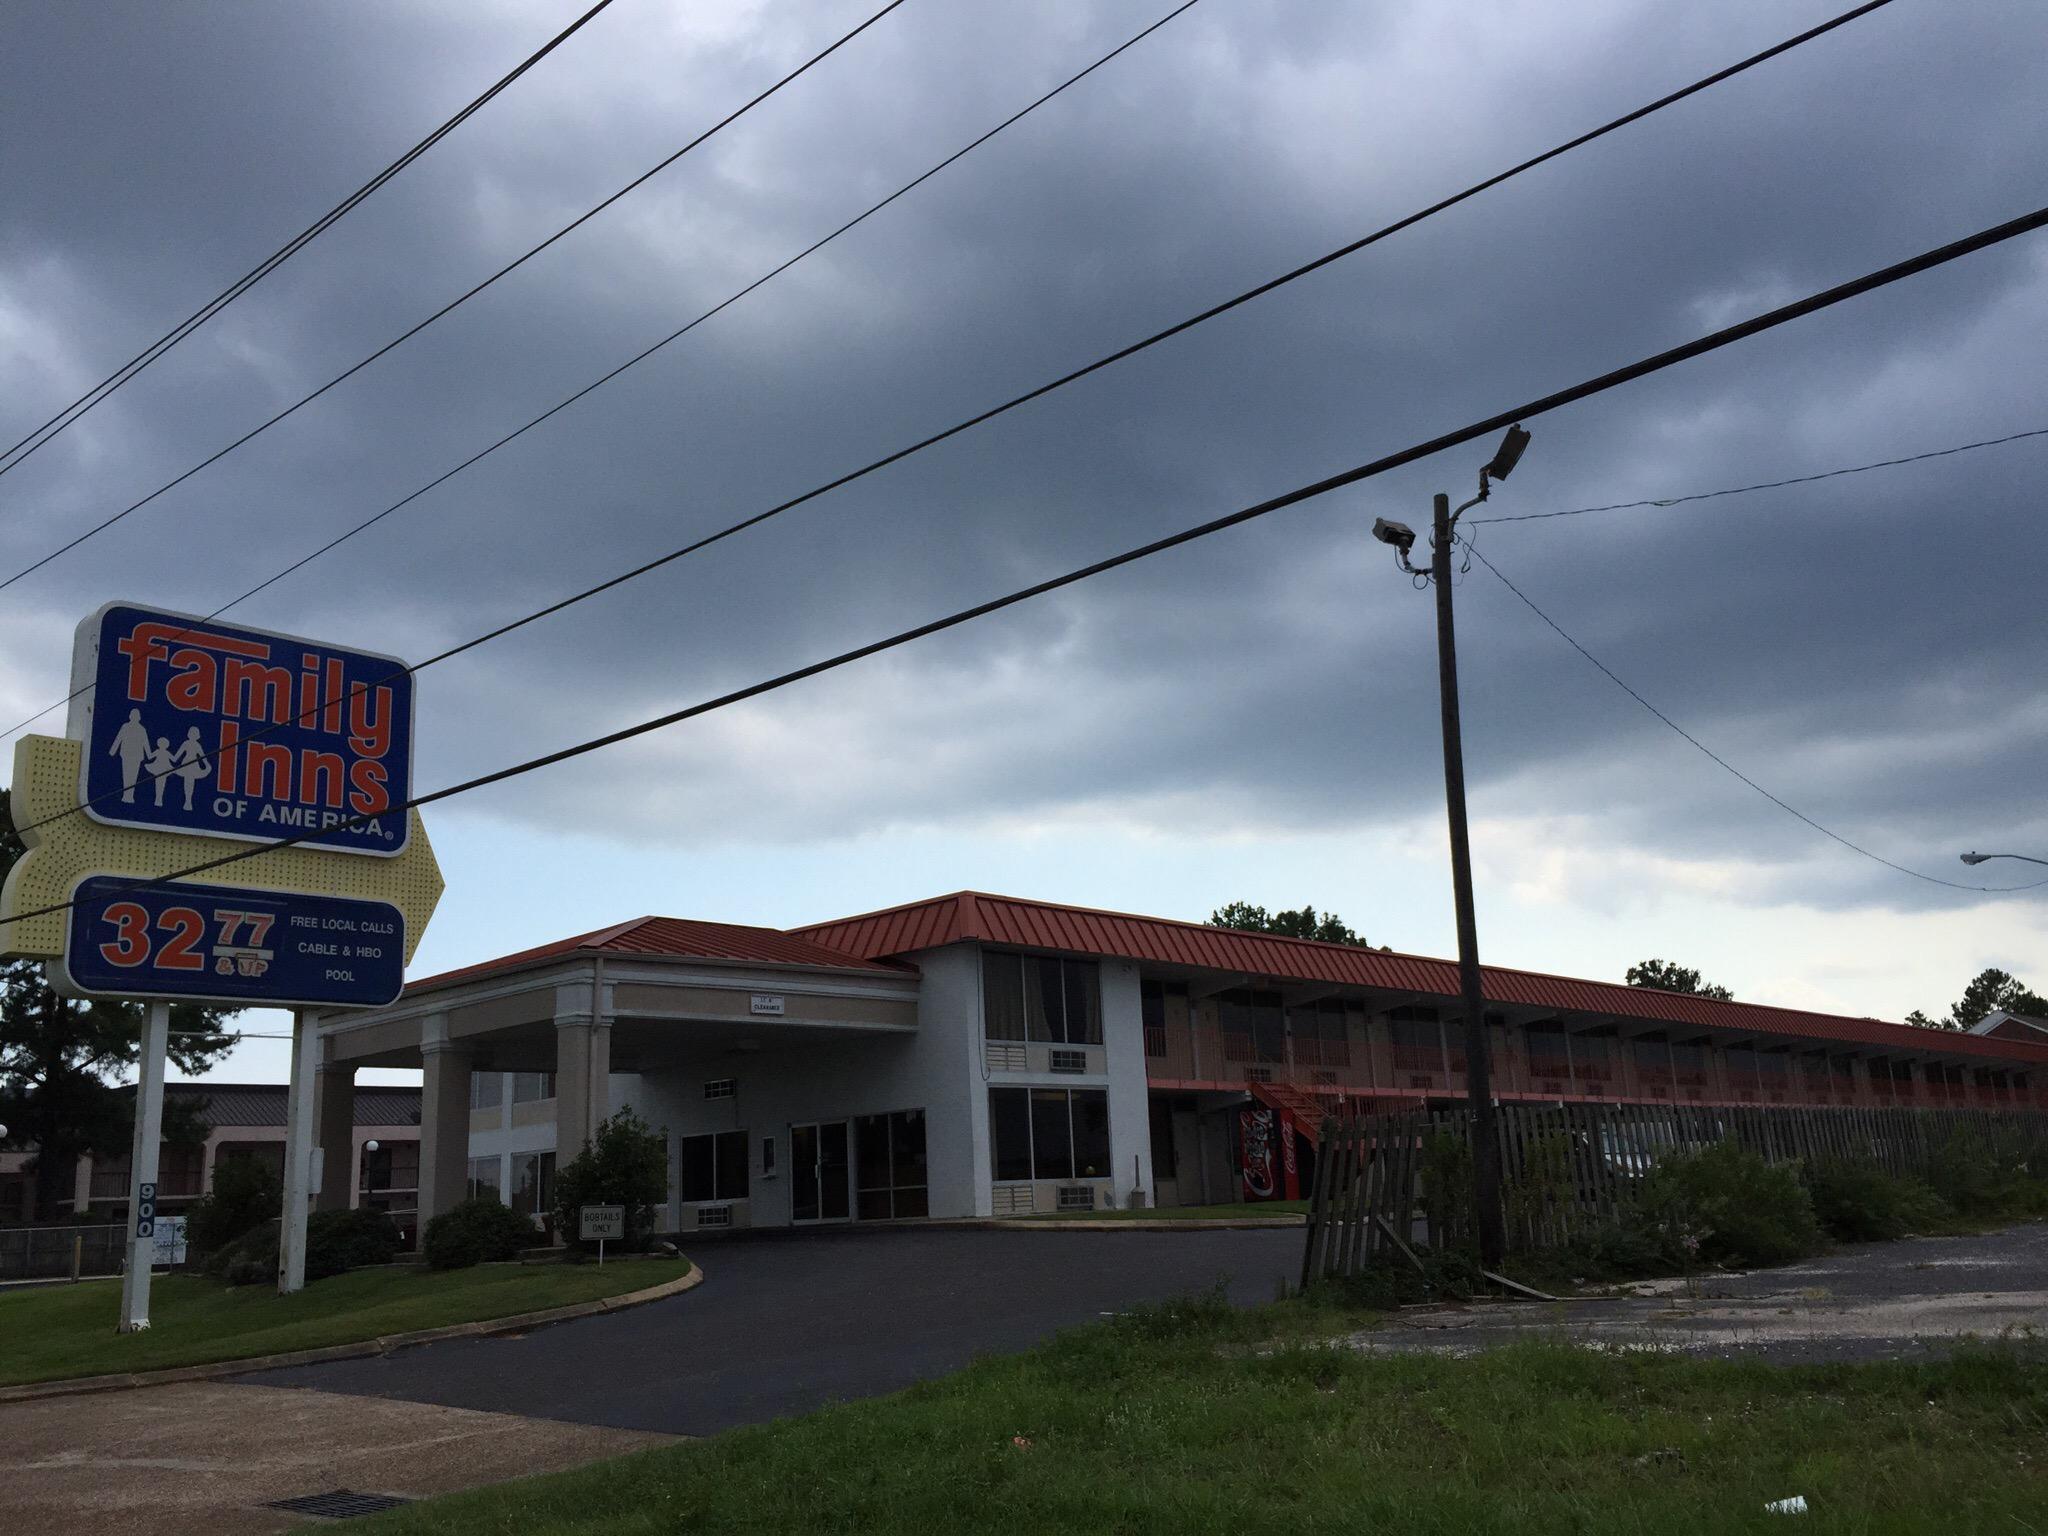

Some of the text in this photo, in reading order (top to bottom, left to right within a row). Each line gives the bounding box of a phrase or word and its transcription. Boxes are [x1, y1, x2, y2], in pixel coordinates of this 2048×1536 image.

[117, 621, 393, 759] family
[216, 720, 389, 816] Inns
[212, 797, 248, 819] OF
[290, 915, 394, 935] FREE LOCAL CALLS
[99, 902, 276, 972] 32 77
[297, 942, 382, 959] CABLE & HBO
[215, 957, 235, 976] &
[325, 969, 355, 982] POOL
[138, 1184, 155, 1237] 900
[584, 1212, 620, 1222] BOBTAILS
[592, 1223, 612, 1233] ONLY
